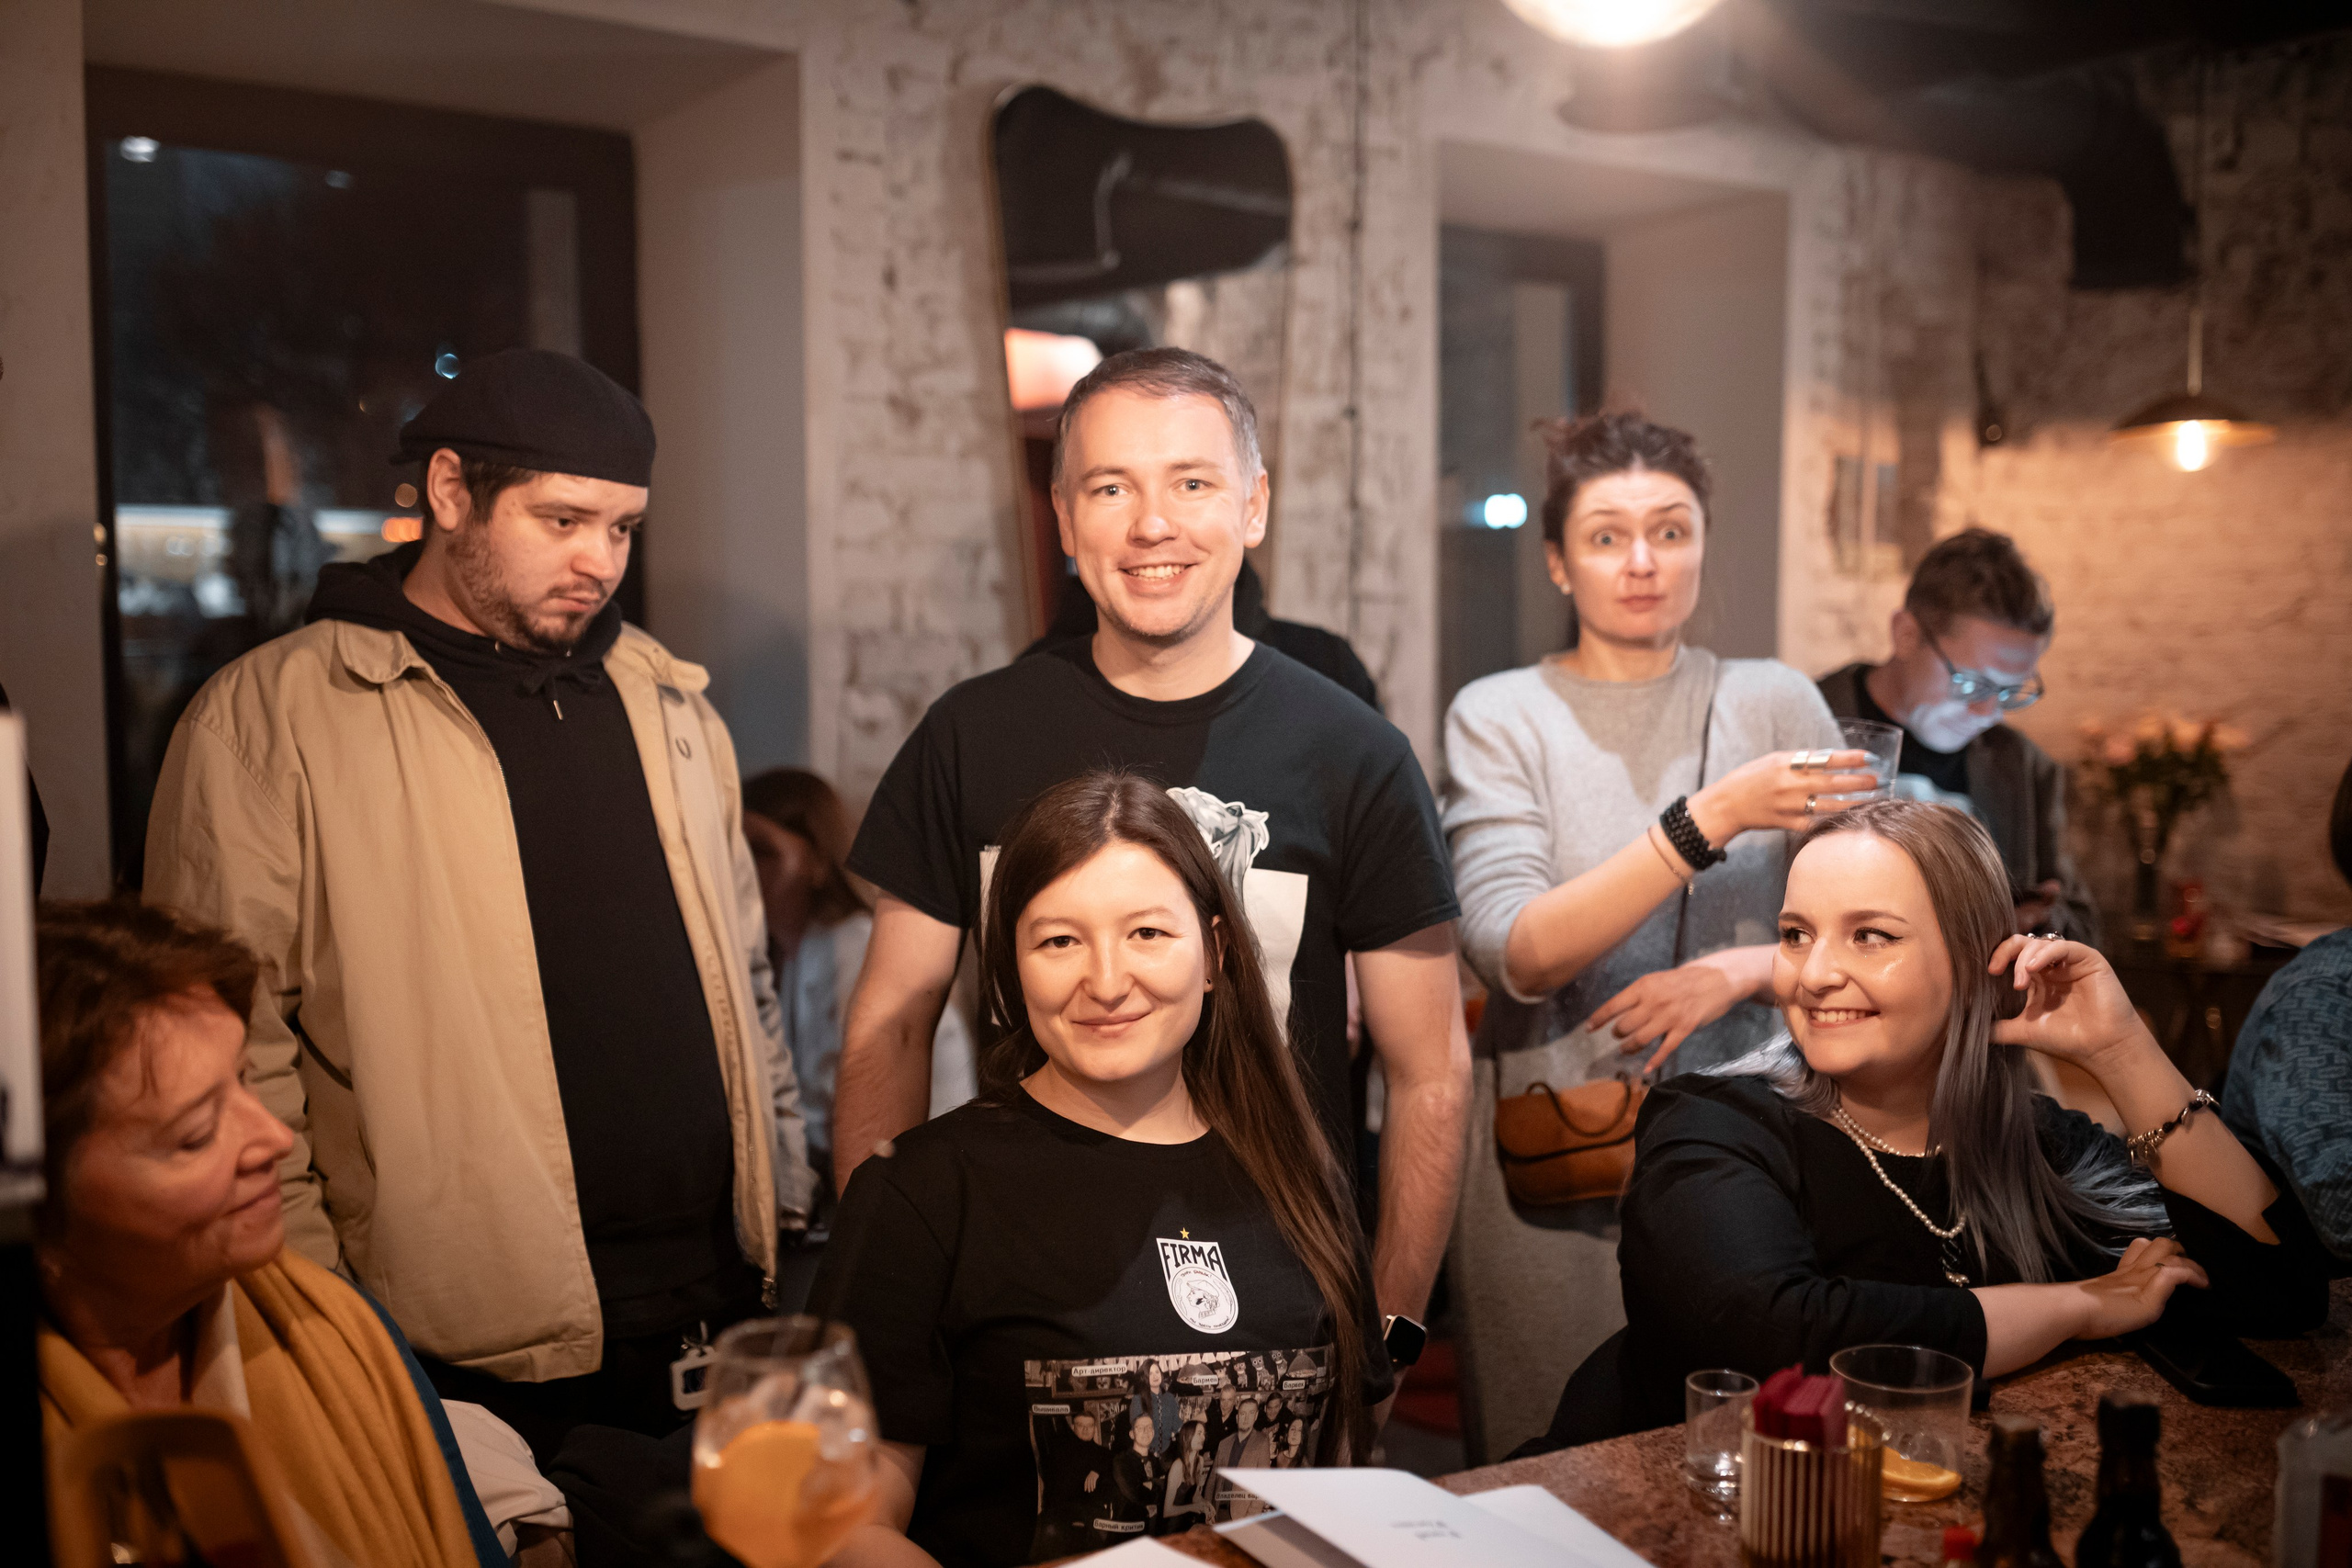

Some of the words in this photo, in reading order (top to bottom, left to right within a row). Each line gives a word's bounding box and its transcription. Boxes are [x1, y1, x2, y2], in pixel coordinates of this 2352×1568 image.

[1159, 1243, 1227, 1282] FIRMA
[1073, 1365, 1125, 1375] Арт-директор
[1094, 1520, 1119, 1530] Барный
[1121, 1522, 1144, 1531] критик
